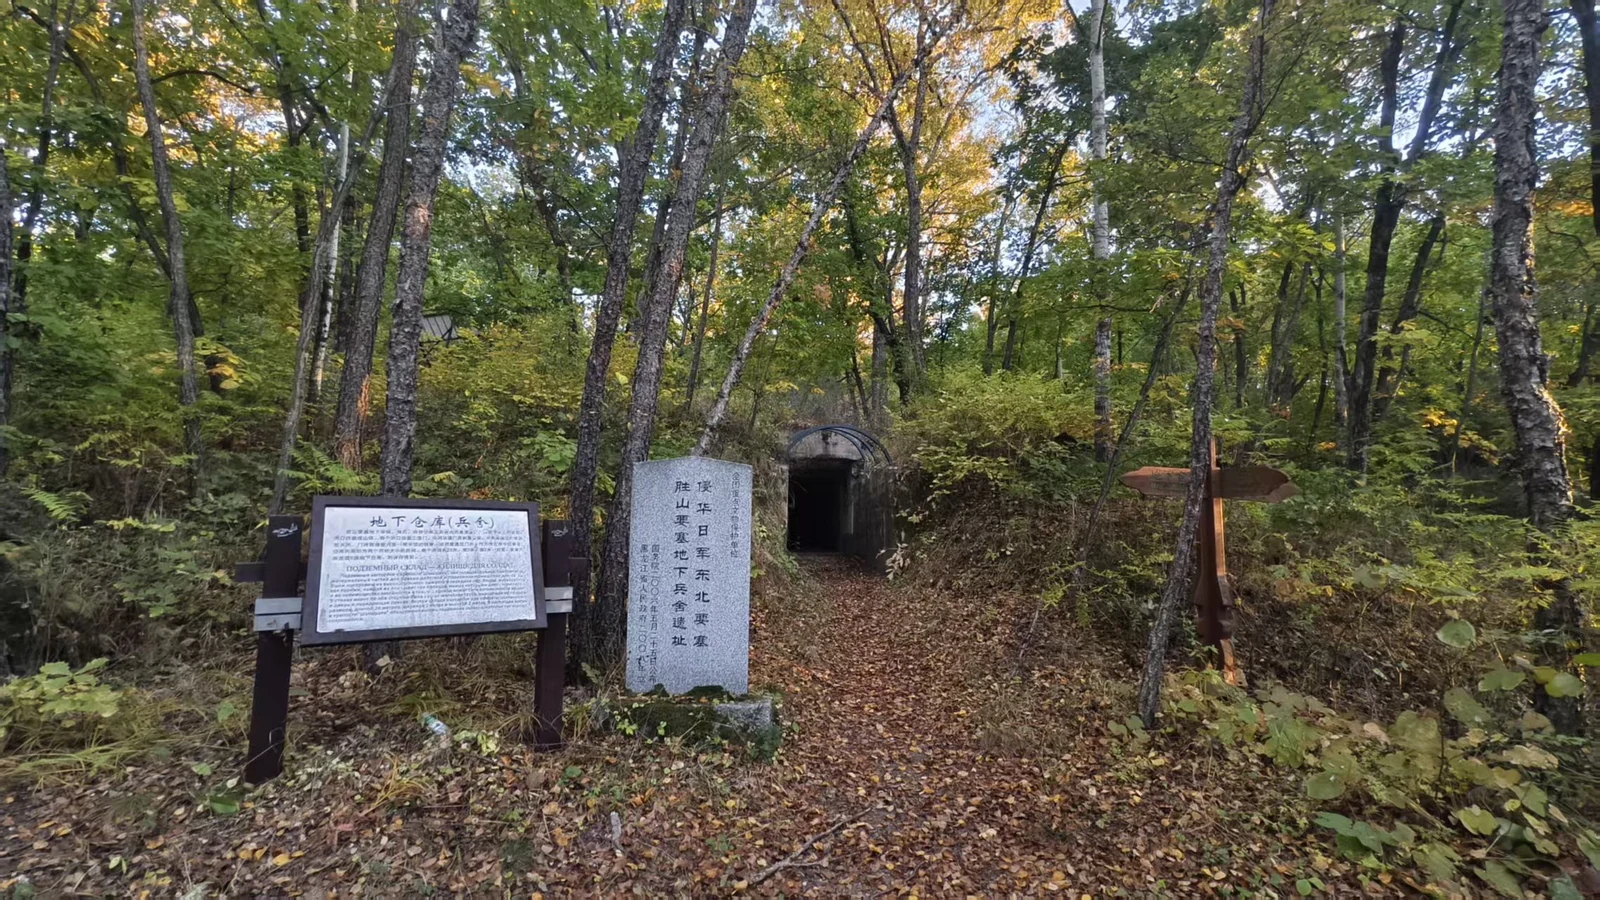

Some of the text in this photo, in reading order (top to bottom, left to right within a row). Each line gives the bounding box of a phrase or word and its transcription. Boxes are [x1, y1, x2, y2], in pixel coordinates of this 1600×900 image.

[671, 480, 691, 647] 胜山要塞地下兵舍遗址
[692, 480, 712, 648] 侵华日军东北要塞
